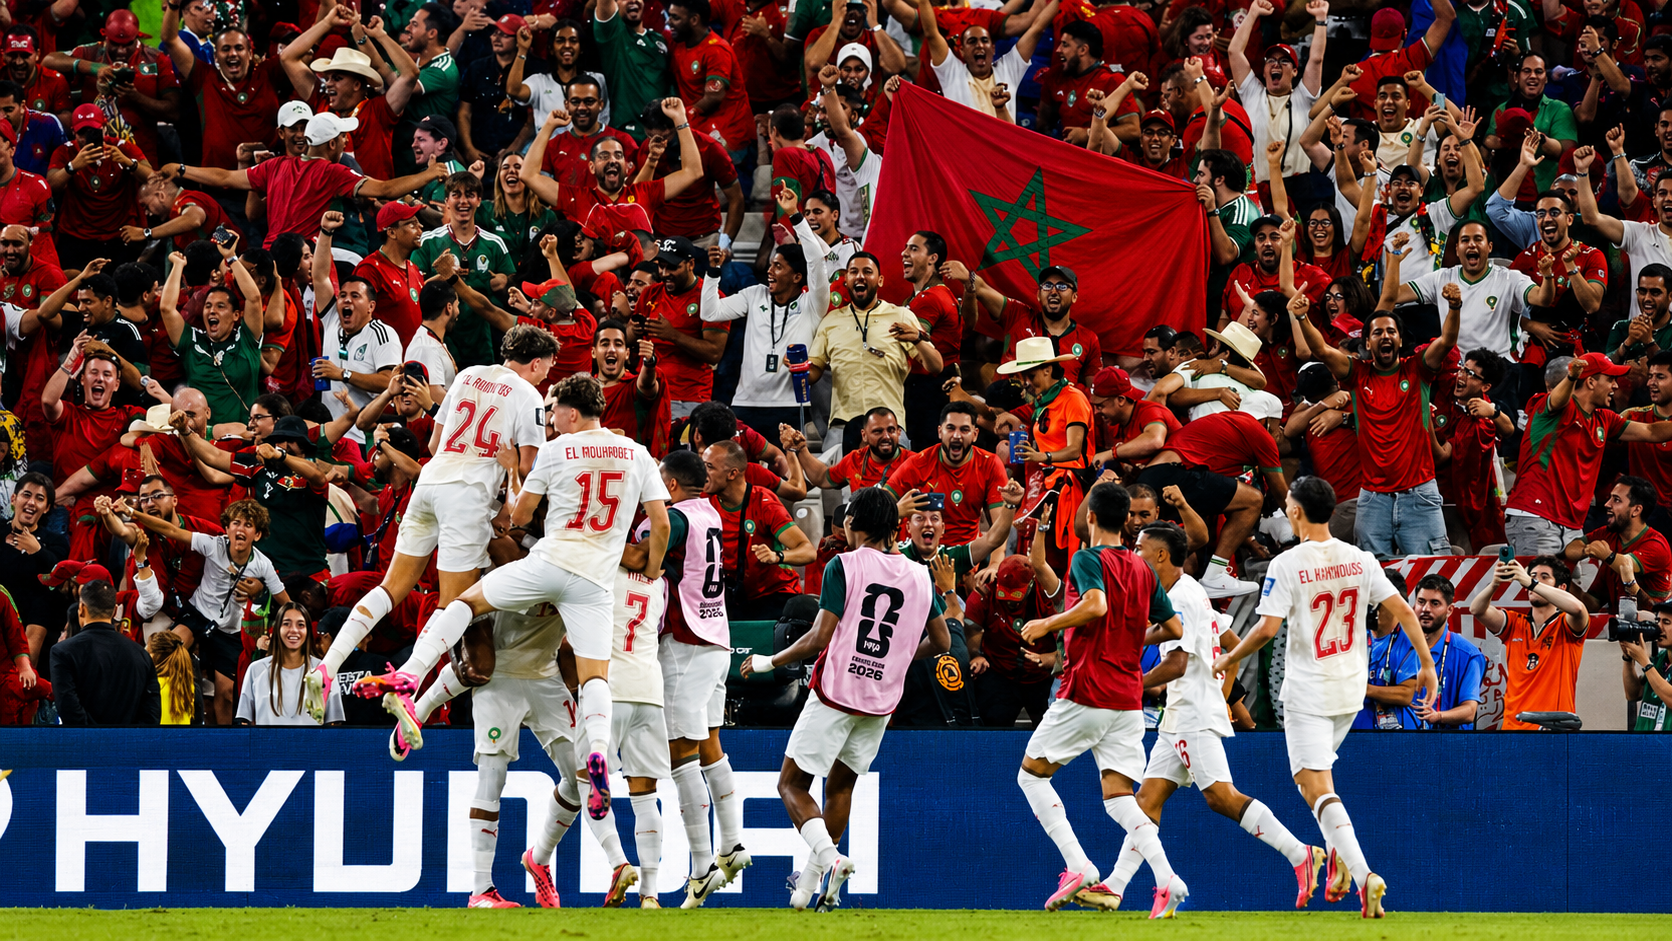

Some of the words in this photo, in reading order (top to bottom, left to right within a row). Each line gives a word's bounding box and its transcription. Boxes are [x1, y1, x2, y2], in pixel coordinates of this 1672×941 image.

[444, 398, 501, 458] 24
[565, 446, 580, 460] EL
[565, 469, 625, 533] 15
[1298, 570, 1313, 584] EL
[623, 590, 651, 654] 7
[1310, 586, 1360, 661] 23
[847, 662, 884, 681] 2026
[54, 769, 880, 893] HYUNDAI
